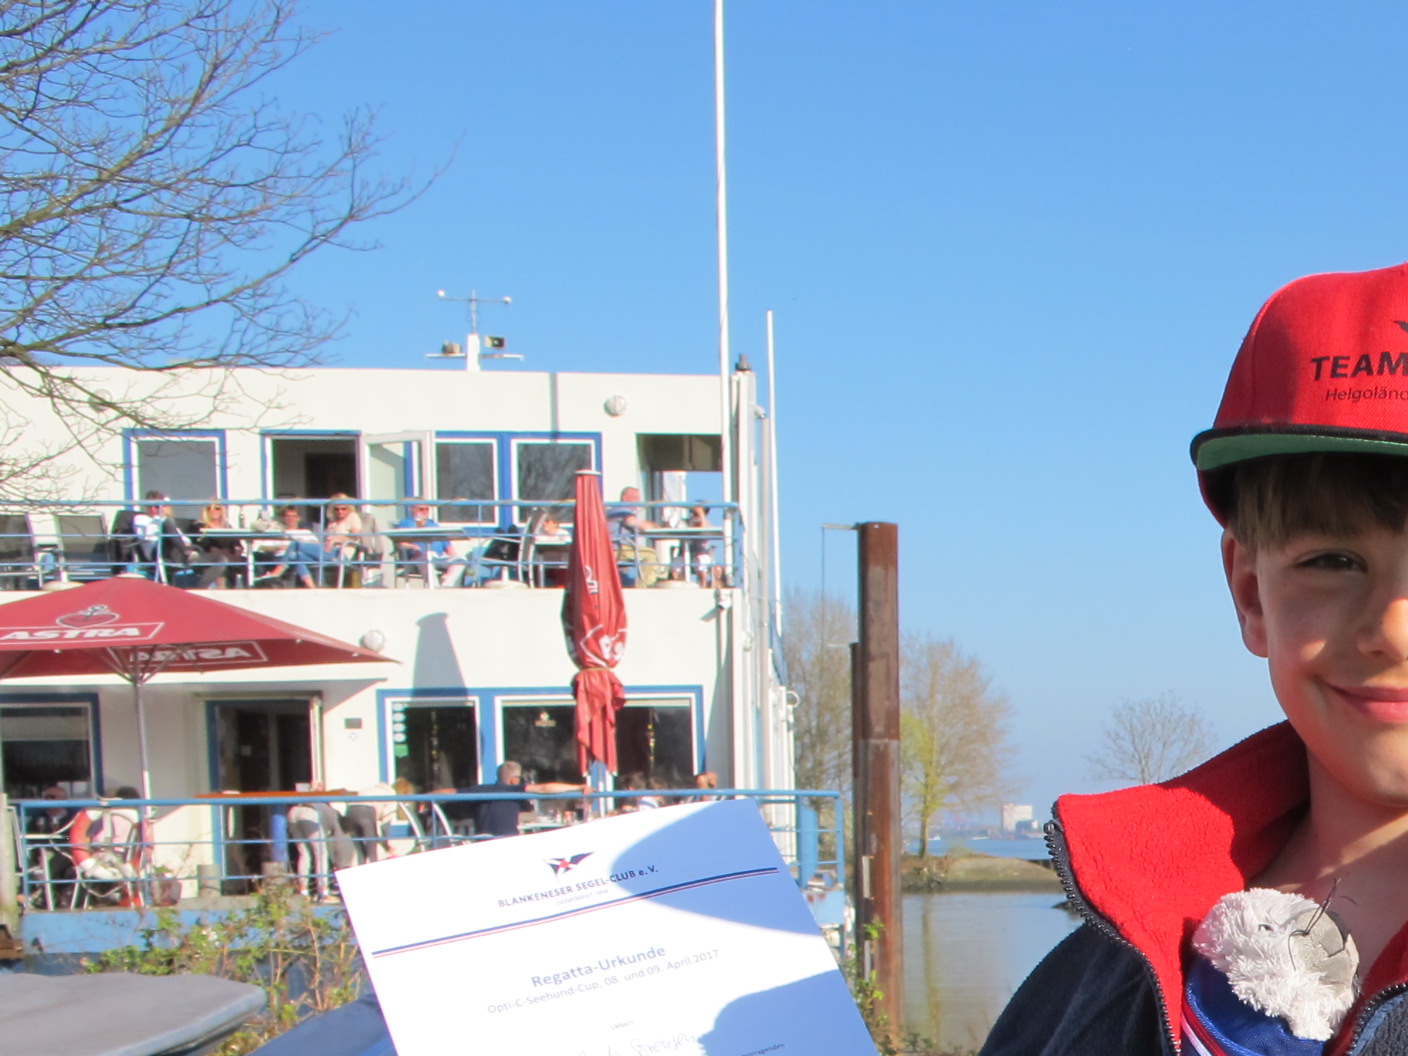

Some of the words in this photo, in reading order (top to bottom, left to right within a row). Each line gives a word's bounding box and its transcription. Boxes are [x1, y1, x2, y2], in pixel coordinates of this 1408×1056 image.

[1, 627, 142, 641] ASTRA
[498, 885, 573, 908] BLANKENESER
[576, 869, 637, 892] SEGEL-CLUB
[487, 980, 603, 1014] Opti-C-Seehund-Cup,
[604, 975, 622, 987] 08.
[624, 969, 646, 982] und
[647, 964, 665, 976] 09.
[666, 957, 692, 972] April
[693, 949, 720, 964] 2017
[530, 946, 667, 988] Regatta-Urkunde
